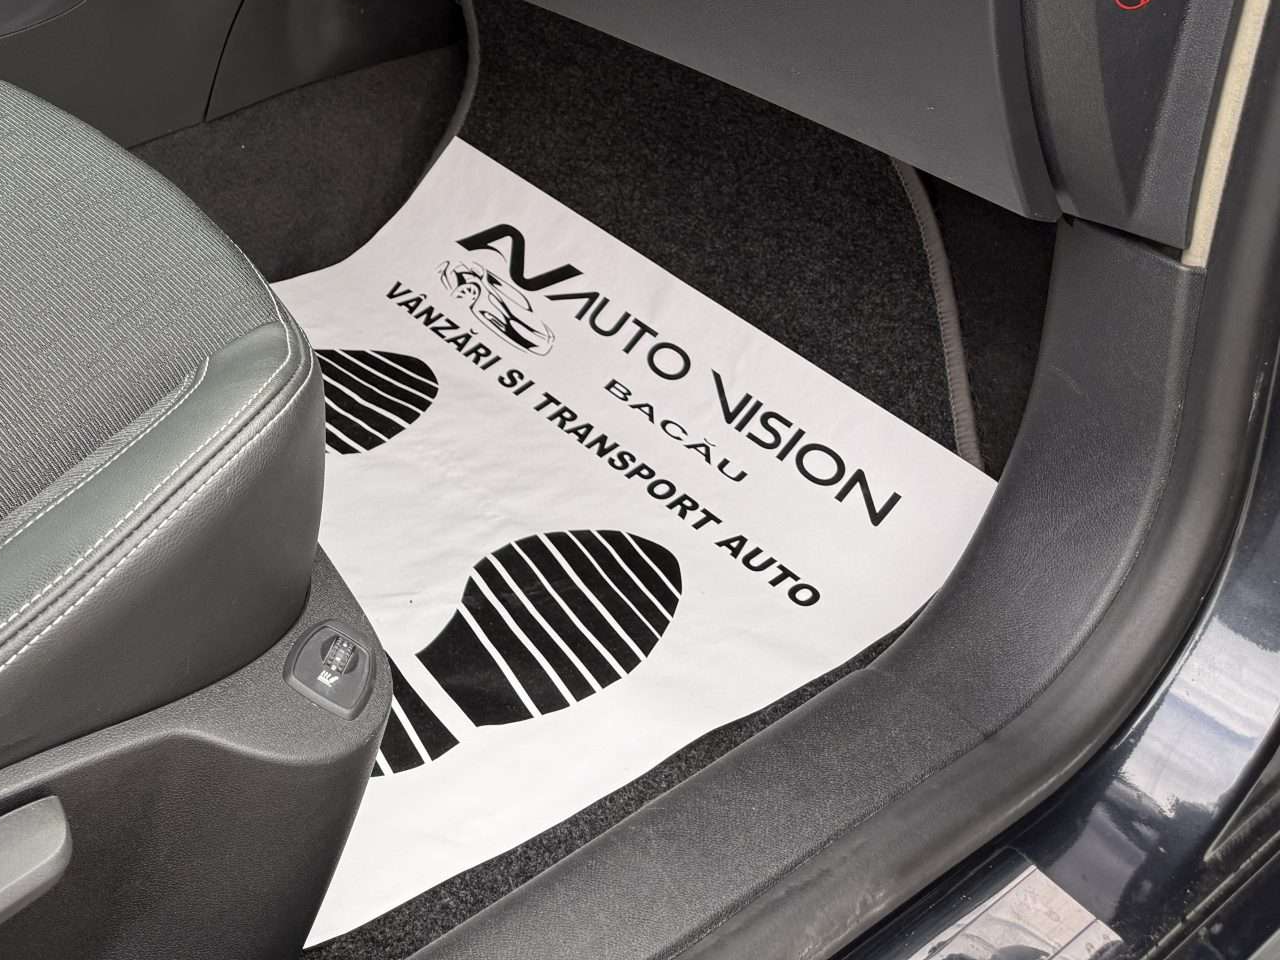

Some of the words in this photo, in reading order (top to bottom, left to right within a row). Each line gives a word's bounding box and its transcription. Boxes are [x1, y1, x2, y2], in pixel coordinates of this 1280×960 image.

[386, 280, 502, 371] VÂNZĂRI
[497, 369, 536, 396] SI
[533, 391, 723, 530] TRANSPORT
[714, 534, 821, 607] AUTO
[545, 291, 691, 381] AUTO
[711, 368, 902, 527] VISION
[604, 378, 748, 482] BACĂU
